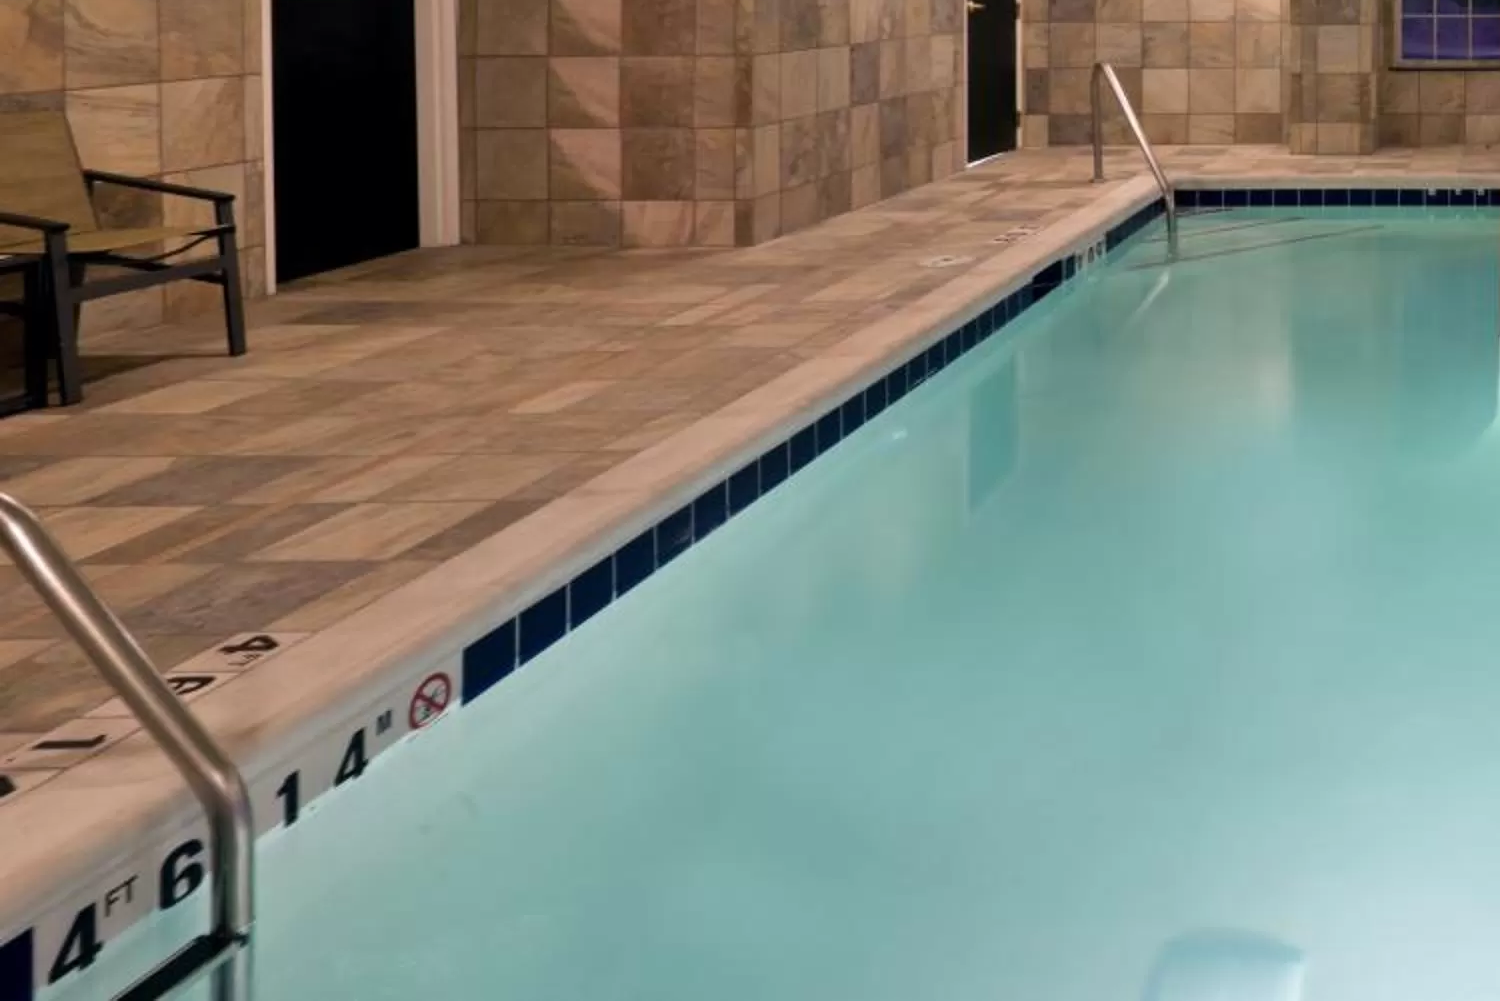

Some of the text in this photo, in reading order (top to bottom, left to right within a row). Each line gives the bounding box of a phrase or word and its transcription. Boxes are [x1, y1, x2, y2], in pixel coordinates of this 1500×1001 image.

[48, 901, 105, 985] 4
[104, 873, 139, 917] FT
[159, 839, 205, 910] 6
[276, 769, 300, 828] 1
[333, 726, 369, 787] 4
